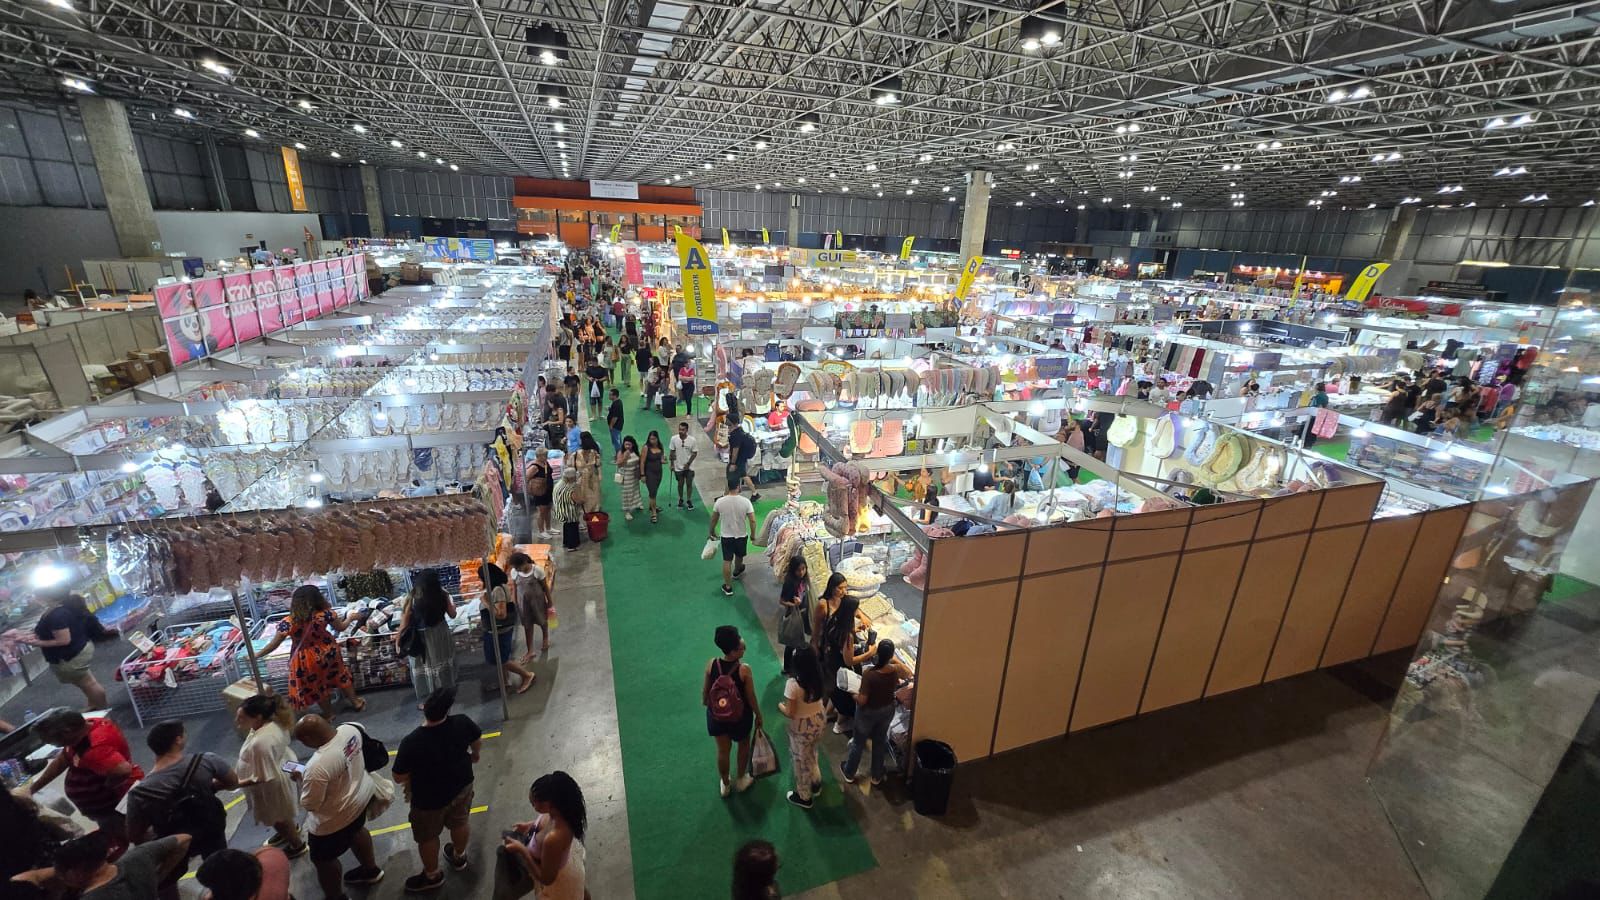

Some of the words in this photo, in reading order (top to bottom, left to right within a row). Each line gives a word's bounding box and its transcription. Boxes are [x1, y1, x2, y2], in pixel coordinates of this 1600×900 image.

[685, 248, 706, 269] A
[818, 252, 842, 262] GUI
[968, 259, 977, 274] B
[1365, 265, 1379, 278] D
[692, 274, 703, 317] CORREDOR
[691, 324, 712, 333] mega
